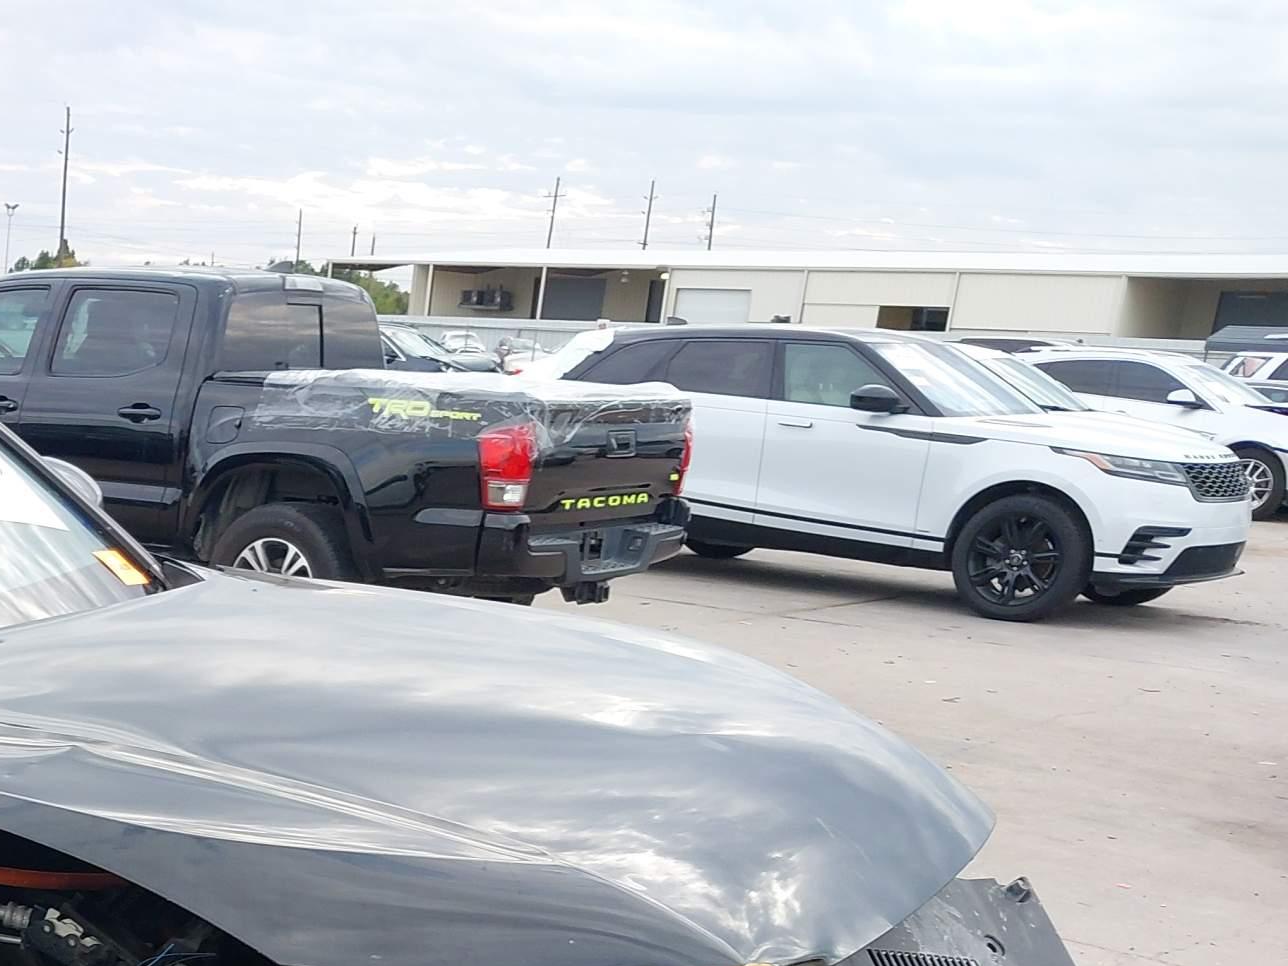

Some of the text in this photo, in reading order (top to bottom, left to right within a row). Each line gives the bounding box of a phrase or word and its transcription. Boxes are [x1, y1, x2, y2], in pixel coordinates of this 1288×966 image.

[368, 397, 482, 421] TRD SPORT
[560, 492, 649, 510] TACOMA
